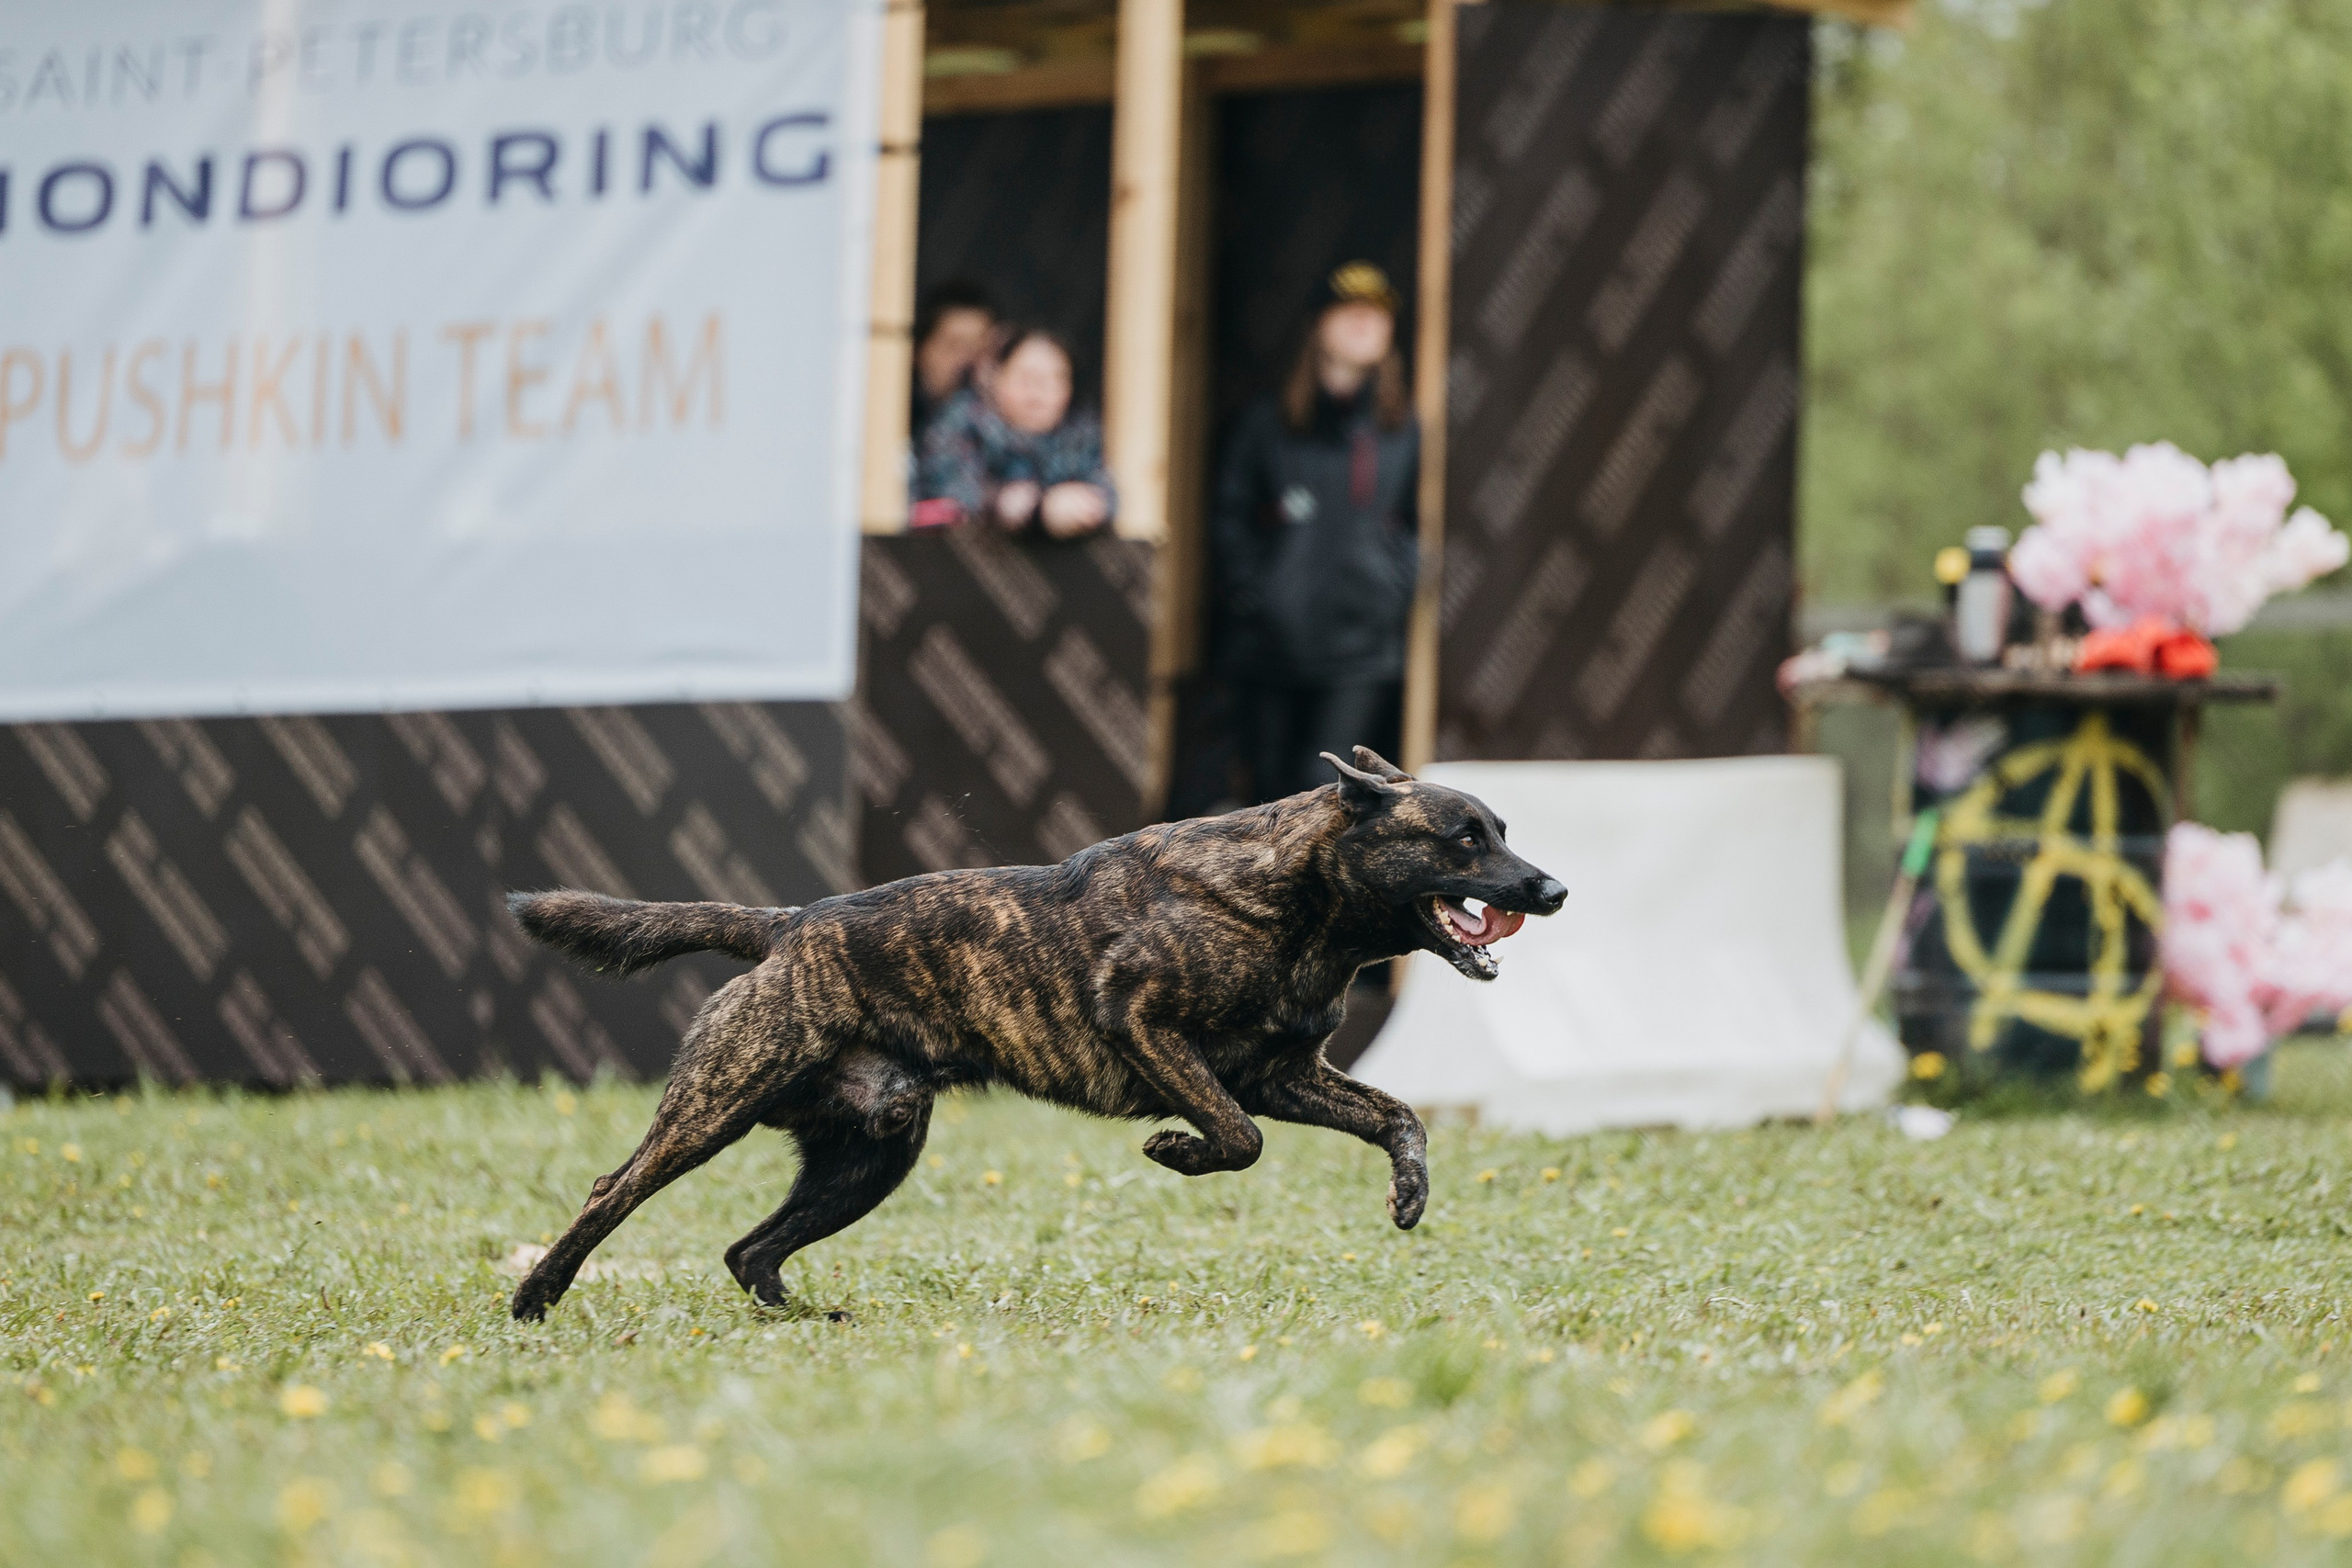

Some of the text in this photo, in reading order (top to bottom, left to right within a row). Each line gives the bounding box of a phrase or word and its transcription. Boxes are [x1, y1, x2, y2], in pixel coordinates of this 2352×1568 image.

[0, 109, 832, 237] ONDIORING
[0, 312, 728, 464] PUSHKIN TEAM
